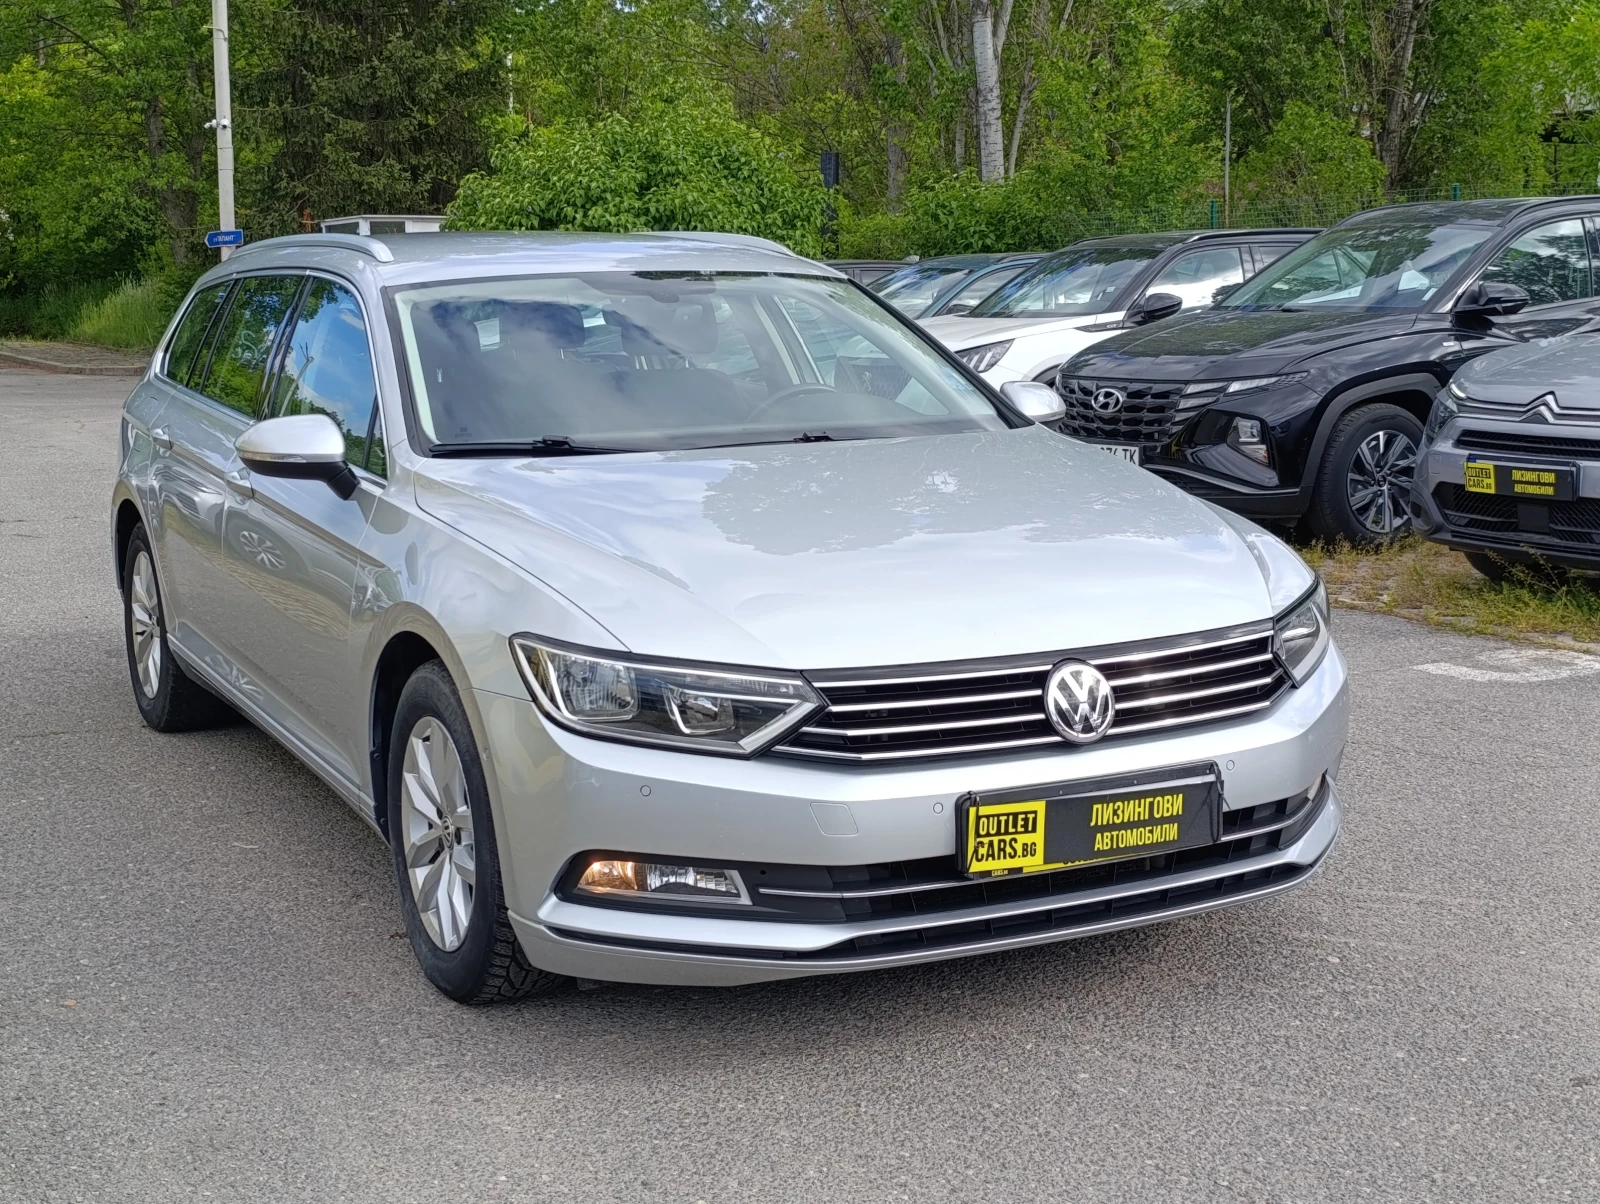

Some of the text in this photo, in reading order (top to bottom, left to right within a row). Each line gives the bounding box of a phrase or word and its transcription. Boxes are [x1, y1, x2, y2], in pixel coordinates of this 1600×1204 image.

[1467, 468, 1491, 479] OUTLET
[1511, 469, 1556, 484] ЛИЗИНГОВИ
[1513, 483, 1555, 495] АВТОМОБИЛИ
[1089, 793, 1184, 827] ЛИЗИНГОВИ
[978, 813, 1036, 836] OUTLET
[1093, 822, 1179, 852] АВТОМОБИЛИ
[974, 837, 1038, 863] CARS.BG
